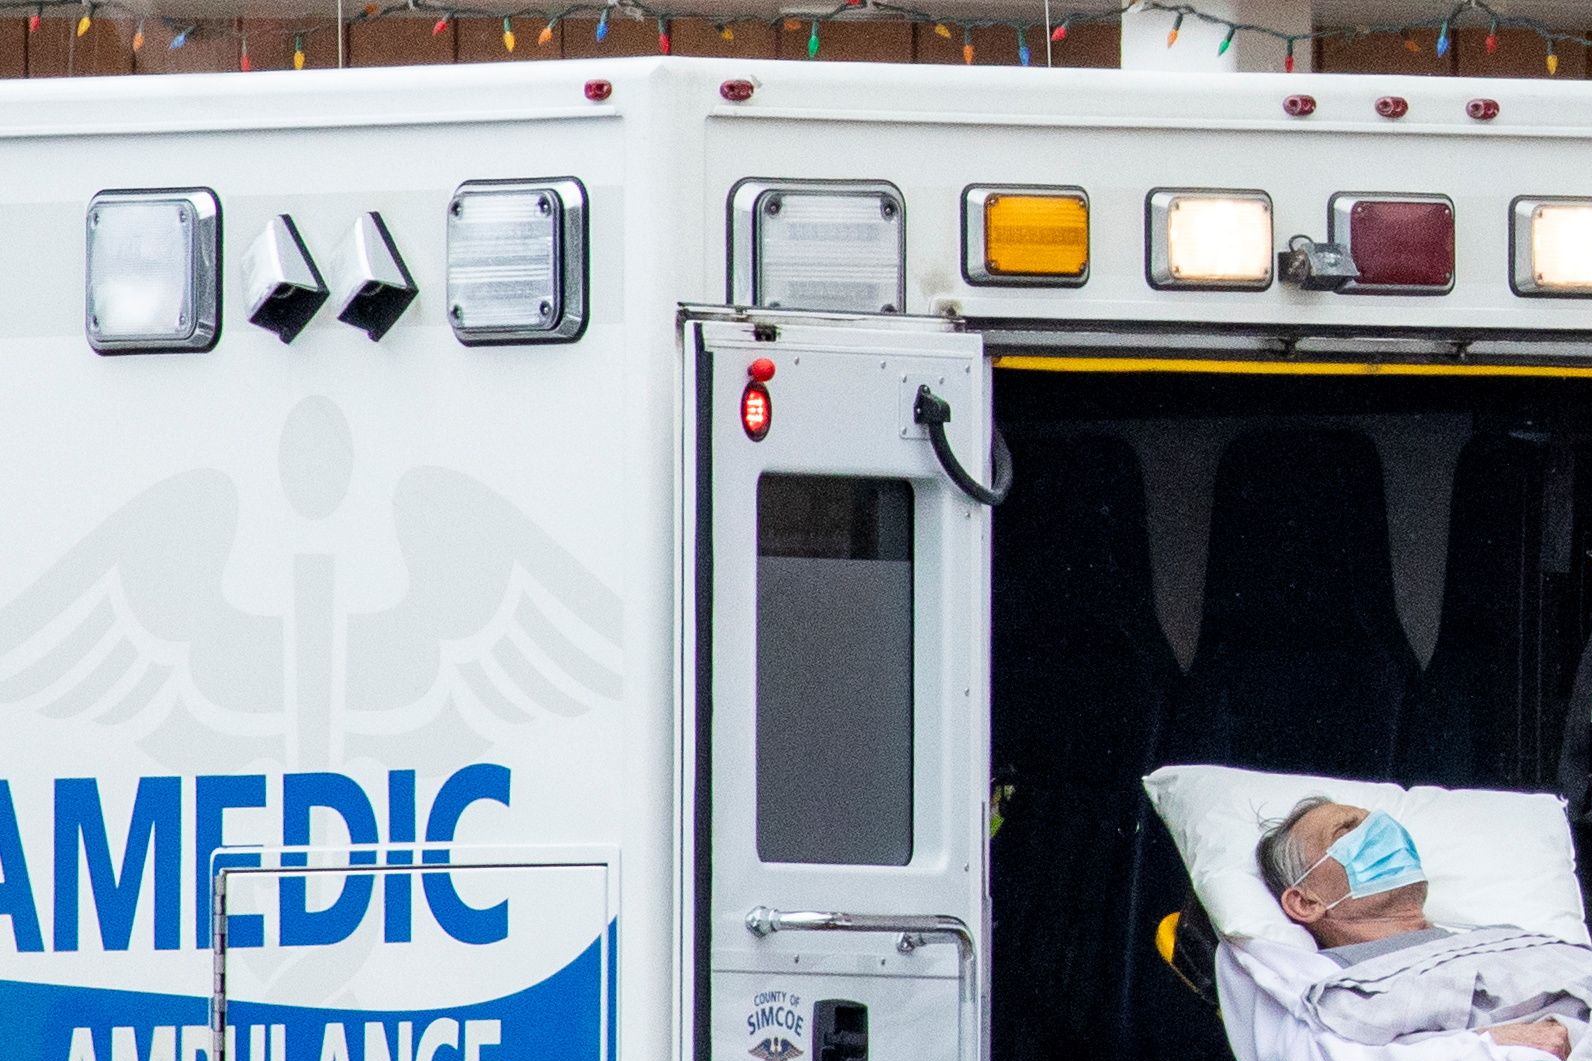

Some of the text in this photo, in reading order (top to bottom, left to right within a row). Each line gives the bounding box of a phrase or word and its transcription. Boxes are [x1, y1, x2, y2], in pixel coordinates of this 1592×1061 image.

[754, 992, 801, 1007] COUNTY OF
[748, 1007, 803, 1037] SIMCOE
